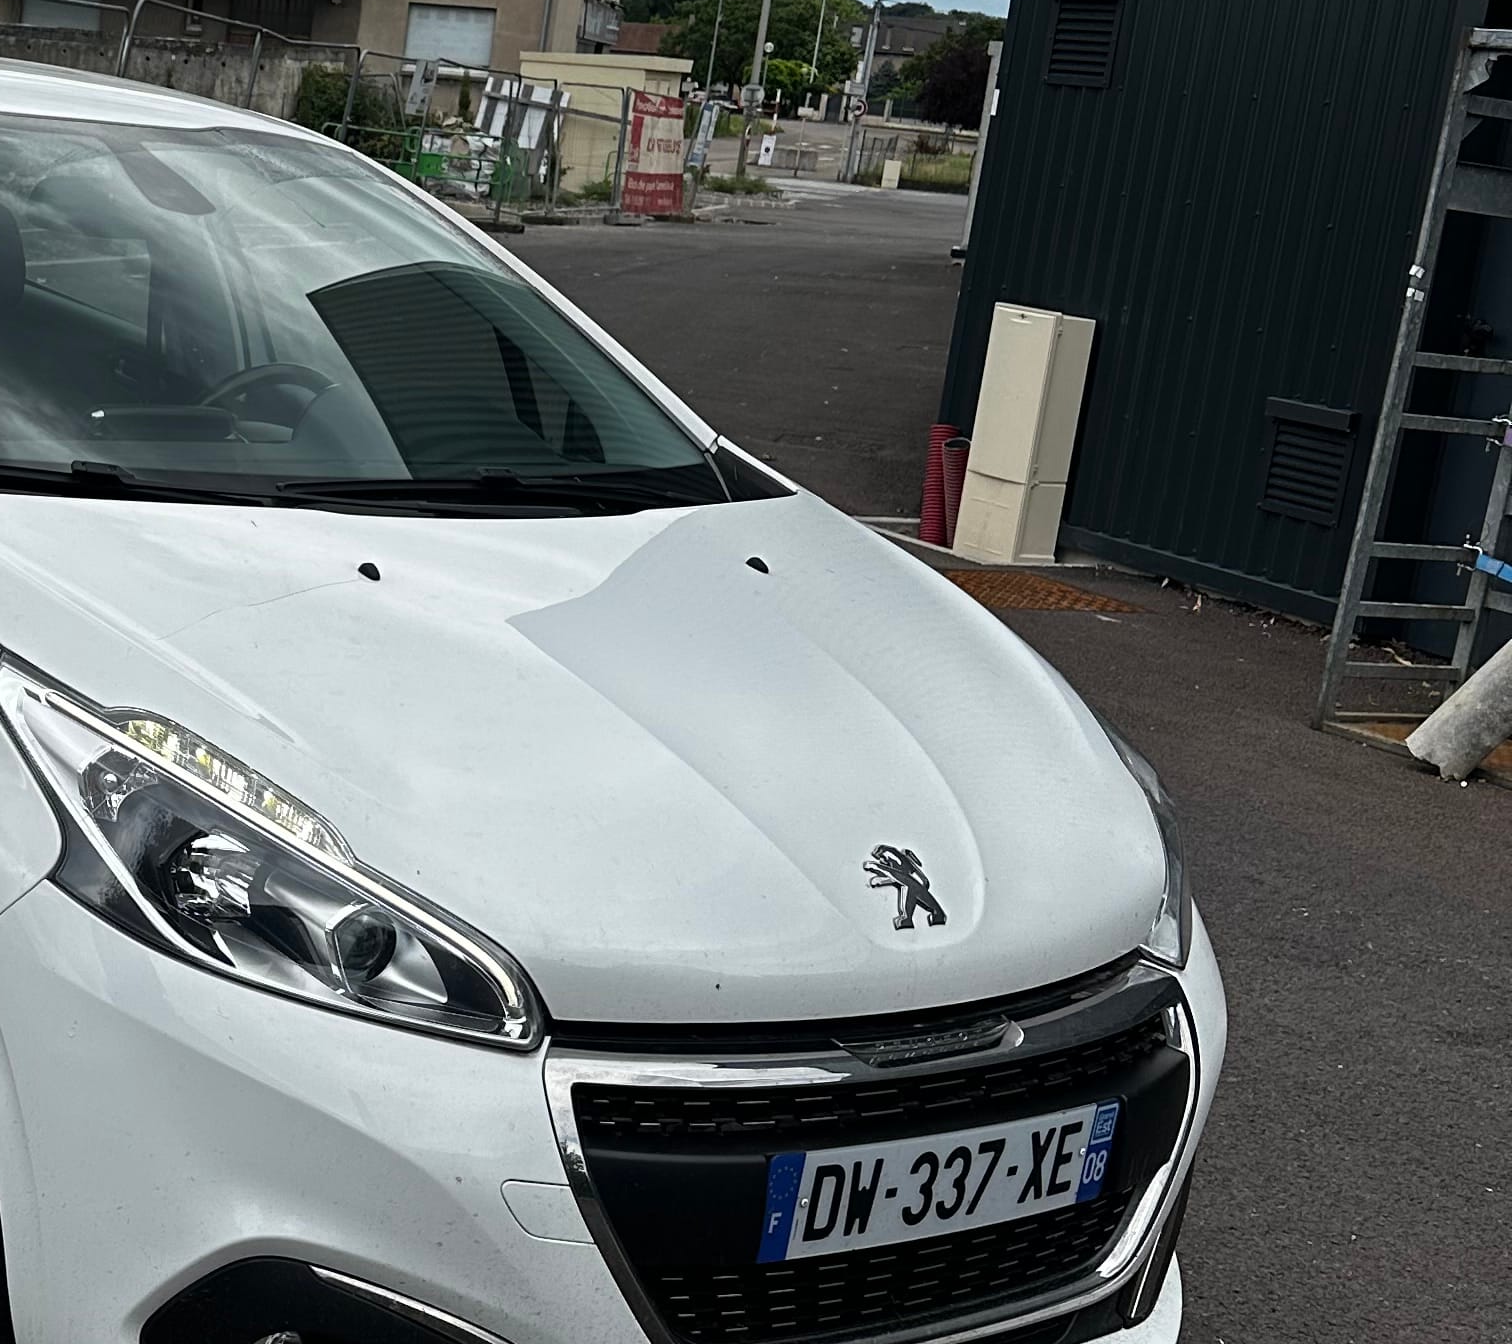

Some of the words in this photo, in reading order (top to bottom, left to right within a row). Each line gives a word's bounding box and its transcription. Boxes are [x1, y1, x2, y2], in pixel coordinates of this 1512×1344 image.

[802, 1121, 1084, 1242] DW-337-XE
[1082, 1150, 1108, 1184] 08
[768, 1212, 782, 1233] F
